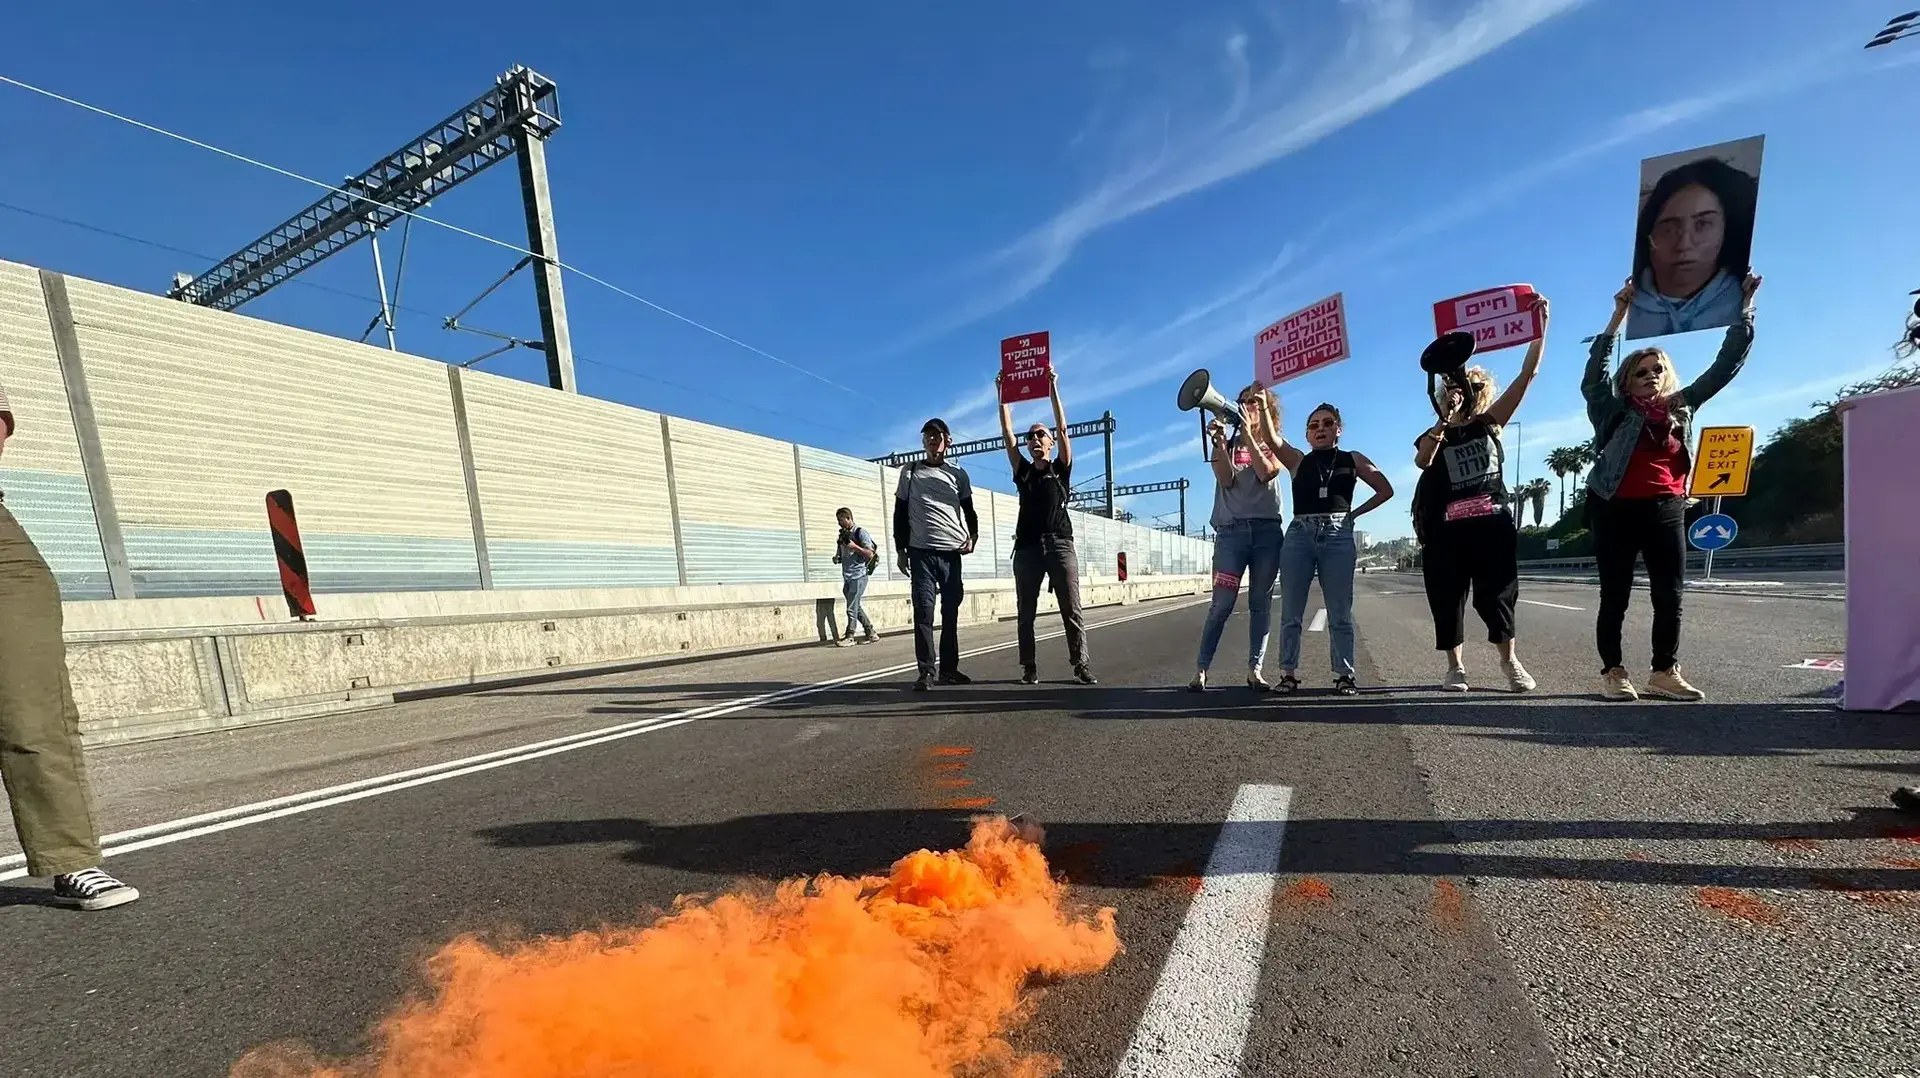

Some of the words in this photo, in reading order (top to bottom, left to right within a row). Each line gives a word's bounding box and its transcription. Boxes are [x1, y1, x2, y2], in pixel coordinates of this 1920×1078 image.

[1465, 296, 1507, 316] חיים
[1284, 299, 1338, 331] עוצרות
[1260, 326, 1280, 344] את
[1287, 313, 1340, 342] העולם
[1470, 326, 1496, 341] מו
[1504, 320, 1523, 336] או
[1019, 338, 1030, 347] מי
[1271, 325, 1341, 361] החטופות
[1004, 346, 1046, 360] שהפקיר
[1302, 341, 1341, 367] עדיין
[1015, 359, 1035, 370] חייב
[1272, 357, 1299, 376] שם
[1007, 367, 1044, 381] להחזיר
[1709, 433, 1744, 442] יציאה
[1454, 442, 1487, 459] אמא
[1709, 448, 1740, 458] خروج
[1707, 460, 1738, 469] EXIT
